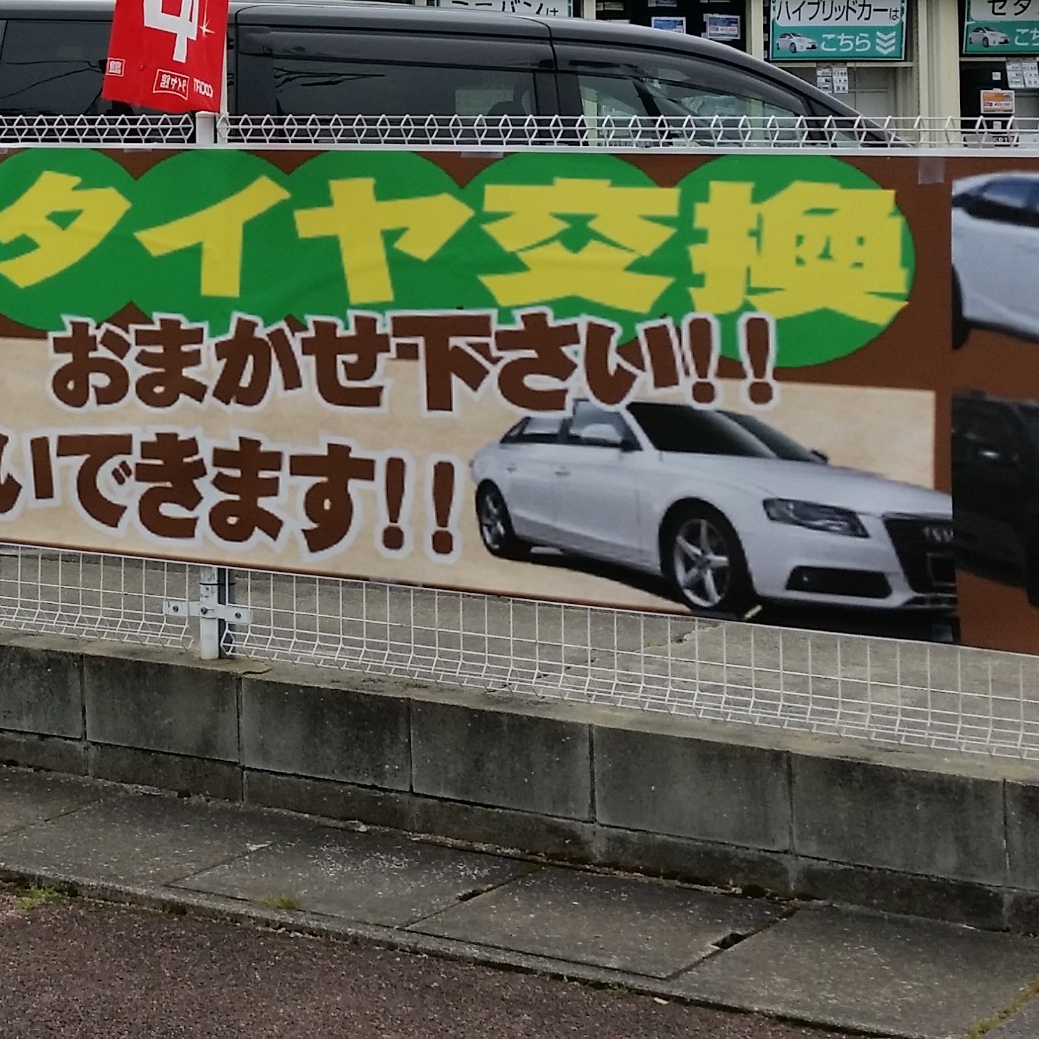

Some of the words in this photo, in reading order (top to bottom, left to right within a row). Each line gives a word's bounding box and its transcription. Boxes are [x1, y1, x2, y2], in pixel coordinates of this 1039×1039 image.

[776, 0, 900, 22] ハイブリッドカーは
[821, 33, 871, 52] こちら
